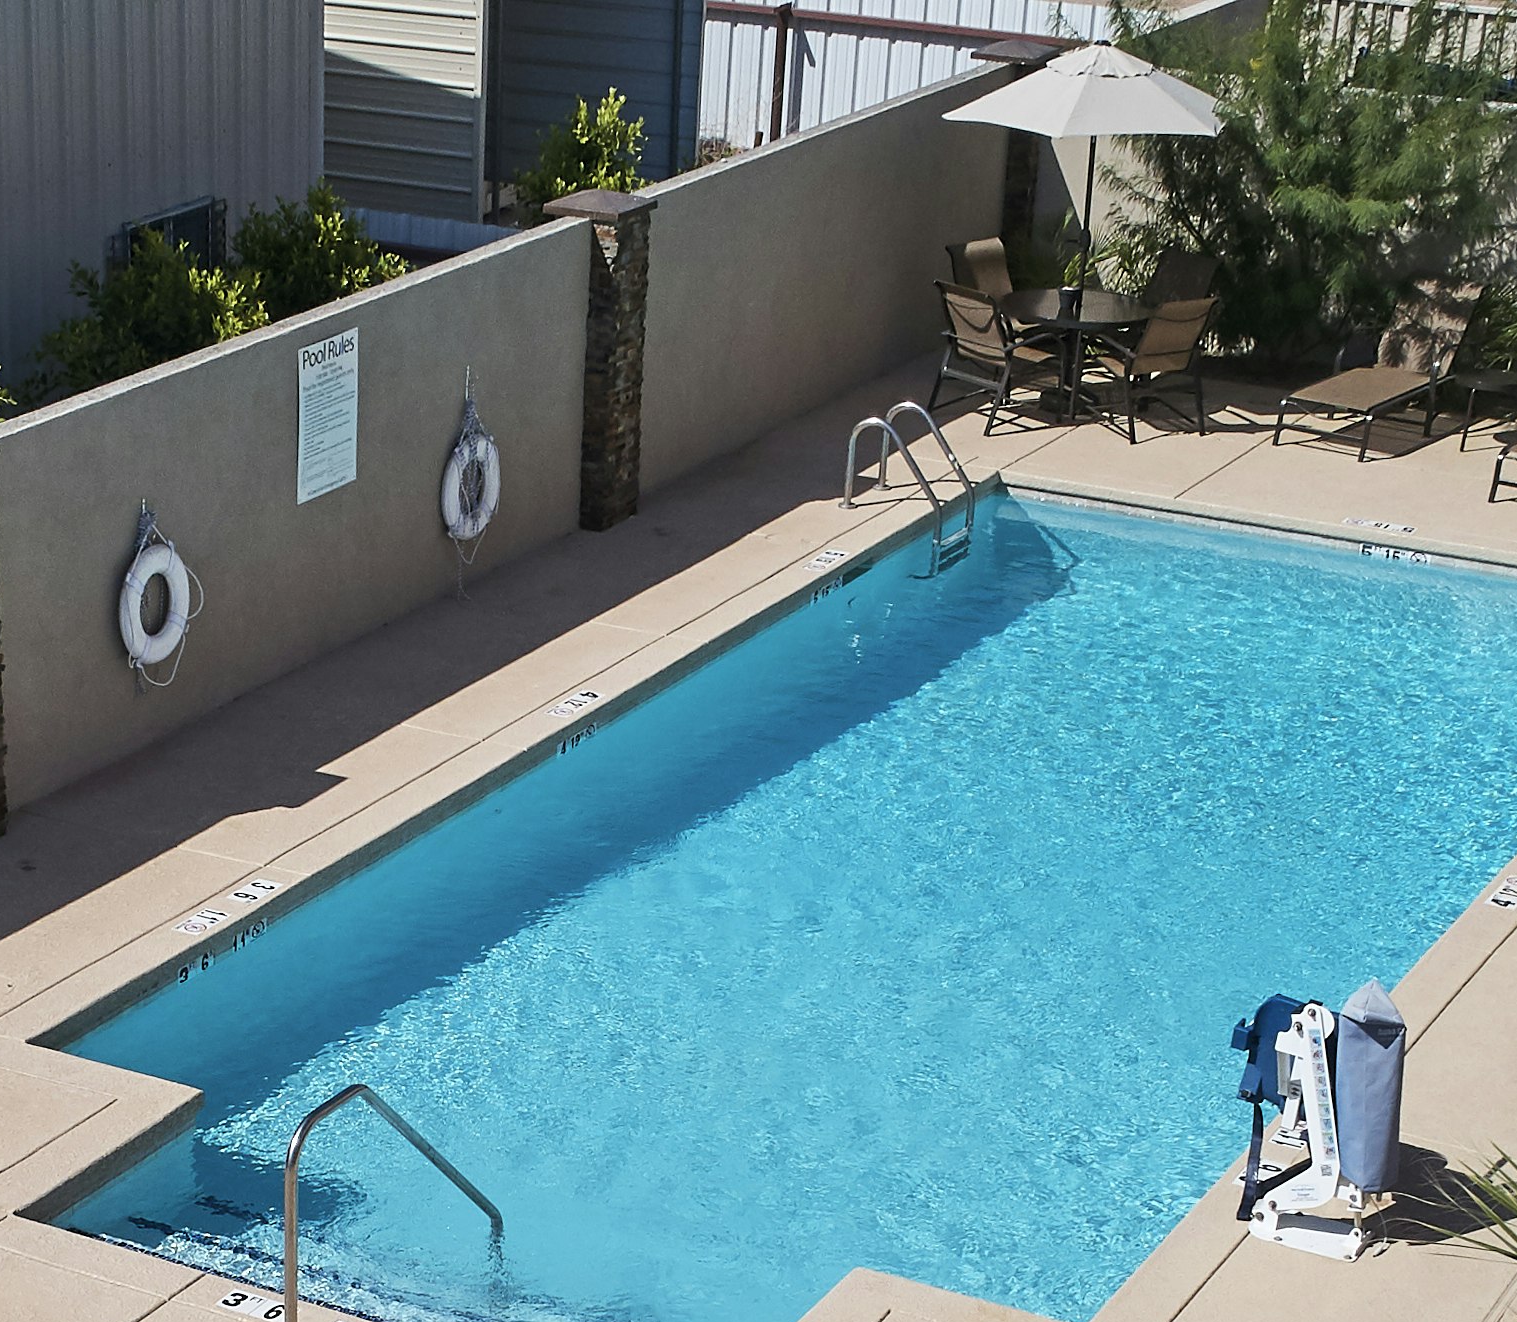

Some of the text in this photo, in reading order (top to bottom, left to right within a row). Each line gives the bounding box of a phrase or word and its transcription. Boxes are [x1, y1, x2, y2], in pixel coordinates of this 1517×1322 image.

[303, 342, 326, 370] Pool
[328, 335, 355, 360] Rules
[1361, 544, 1372, 556] 5
[251, 882, 275, 890] 3
[233, 892, 258, 900] 6
[1491, 898, 1516, 907] 4
[179, 966, 189, 984] 3
[201, 952, 209, 970] 6
[222, 1292, 249, 1307] 3
[263, 1304, 285, 1320] 6
